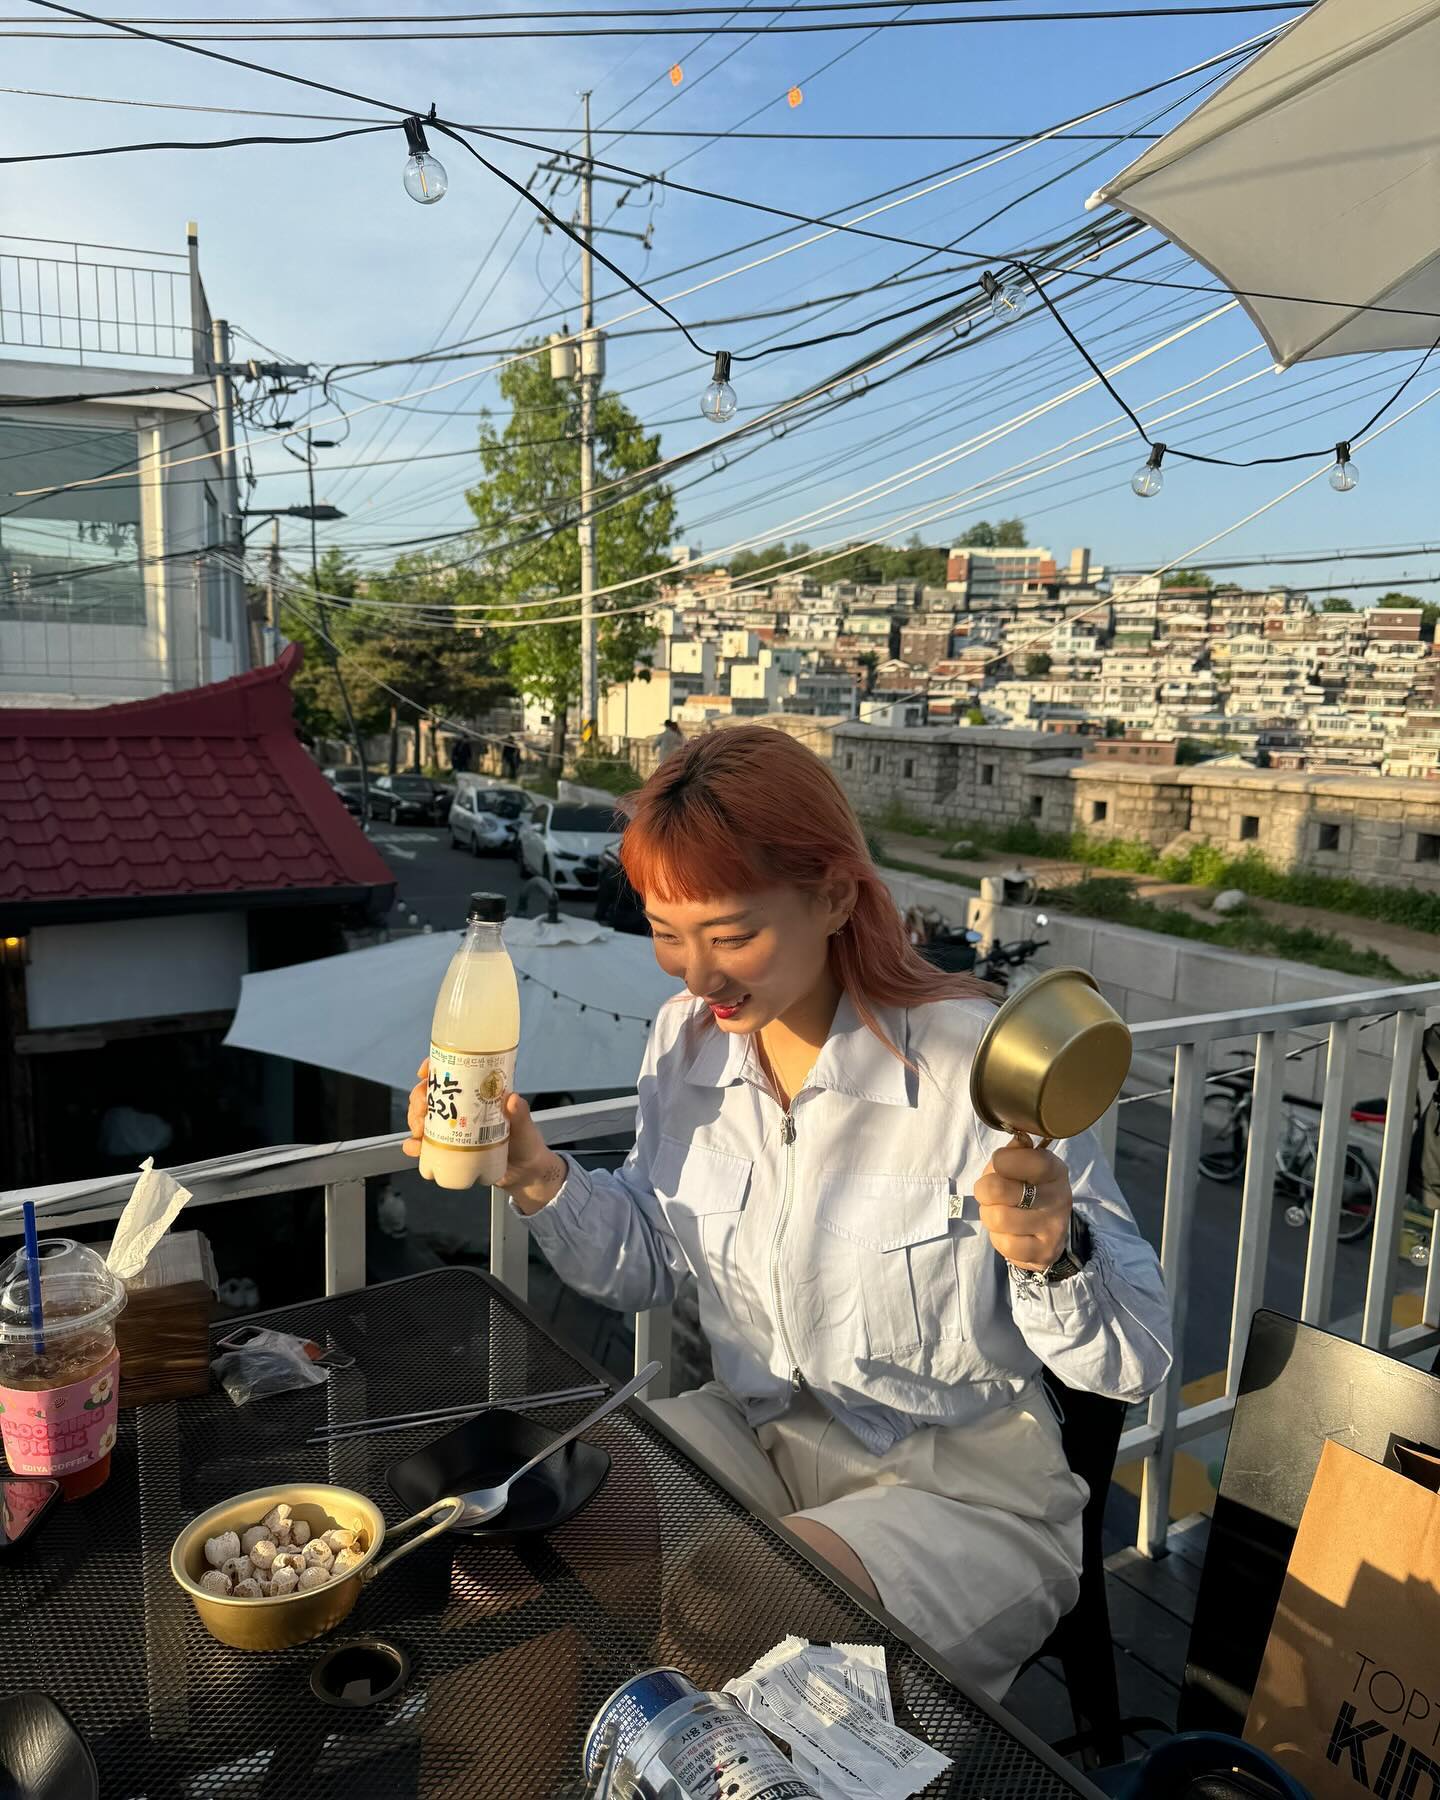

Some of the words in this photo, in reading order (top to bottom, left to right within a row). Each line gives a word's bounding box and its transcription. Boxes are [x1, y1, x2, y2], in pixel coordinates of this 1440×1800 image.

[18, 1431, 88, 1456] PICNIC
[22, 1464, 48, 1473] EDIYA
[51, 1455, 89, 1472] COFFEE
[681, 1727, 700, 1744] 사용
[702, 1719, 712, 1729] 상
[695, 1748, 711, 1763] 사용을
